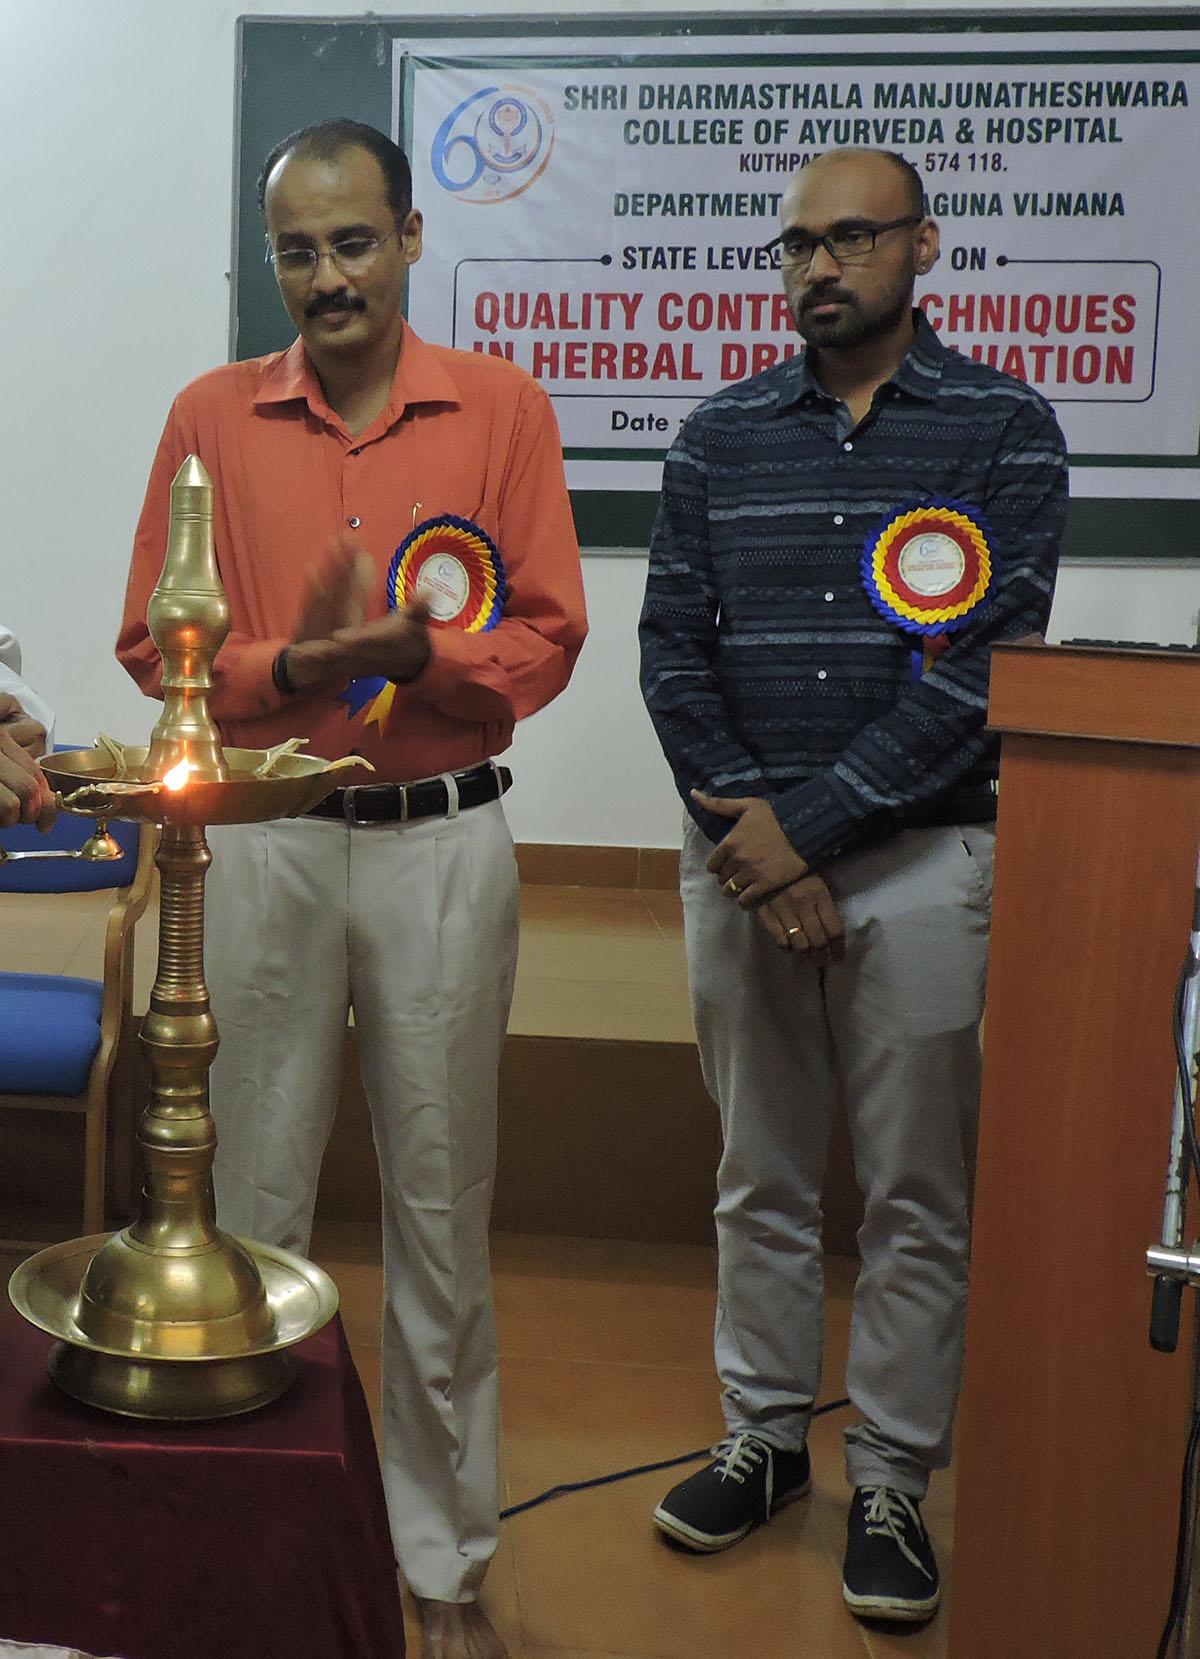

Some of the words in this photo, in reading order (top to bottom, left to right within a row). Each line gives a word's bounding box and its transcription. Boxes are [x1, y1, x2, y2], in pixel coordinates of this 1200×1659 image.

[564, 85, 627, 111] SHRI
[638, 83, 862, 110] DHARMASTHALA
[874, 81, 1189, 108] MANJUNATHESHWARA
[623, 119, 743, 145] COLLEGE
[754, 119, 789, 145] OF
[798, 118, 945, 144] AYURVEDA
[955, 117, 975, 144] &
[986, 117, 1123, 143] HOSPITAL
[739, 152, 822, 172] KUTHPA
[925, 152, 960, 172] 574
[968, 152, 1008, 172] 118.
[613, 193, 783, 216] DEPARTMENT
[1013, 192, 1125, 216] VIJNANA
[622, 246, 697, 270] STATE
[707, 246, 782, 270] LEVEL
[951, 246, 987, 271] ON
[474, 291, 644, 335] QUALITY
[657, 292, 797, 331] CONTR
[918, 293, 1137, 338] CHNIQUES
[532, 341, 704, 381] HERBAL
[611, 410, 669, 431] Date
